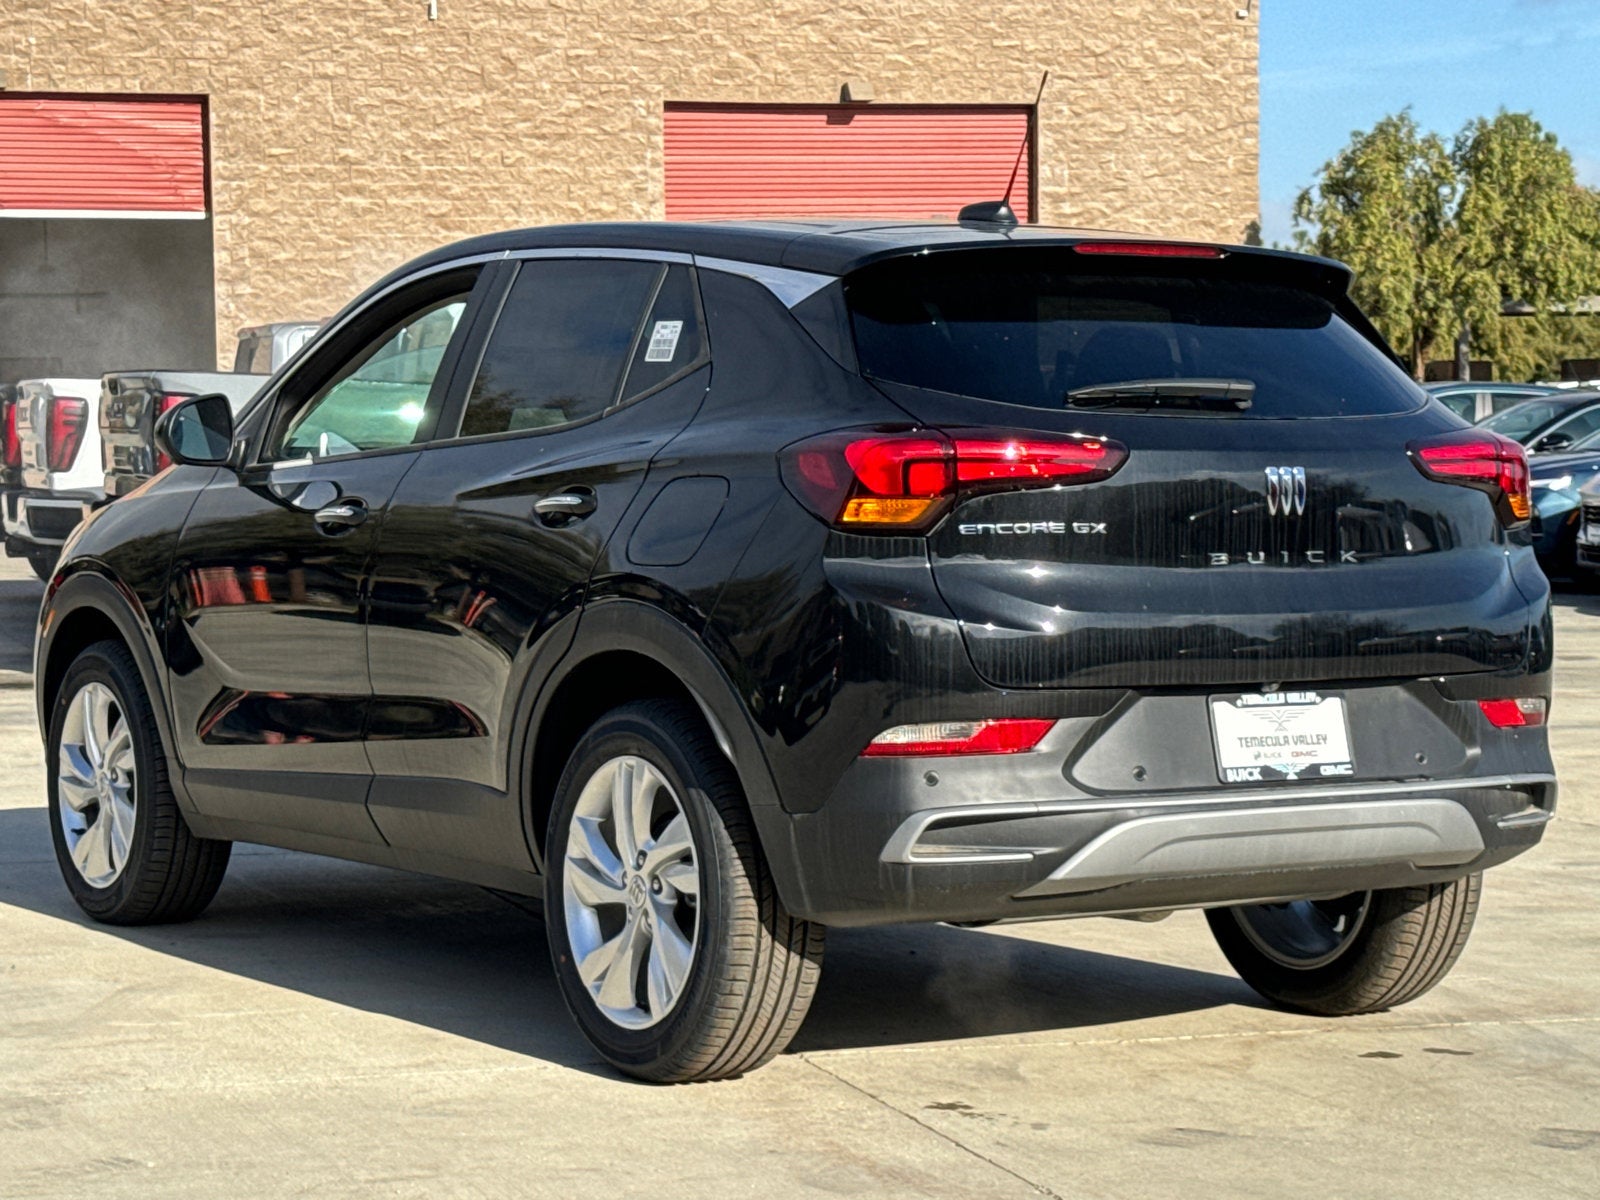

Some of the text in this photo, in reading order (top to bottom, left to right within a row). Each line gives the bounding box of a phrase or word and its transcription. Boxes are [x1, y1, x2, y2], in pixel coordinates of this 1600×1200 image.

[958, 521, 1108, 535] ENCORE GX
[1208, 550, 1358, 566] BUICK
[1237, 734, 1328, 749] TEMECULA VALLEY
[1291, 750, 1319, 758] GMC
[1226, 767, 1263, 782] BUICK
[1319, 764, 1354, 776] GMC
